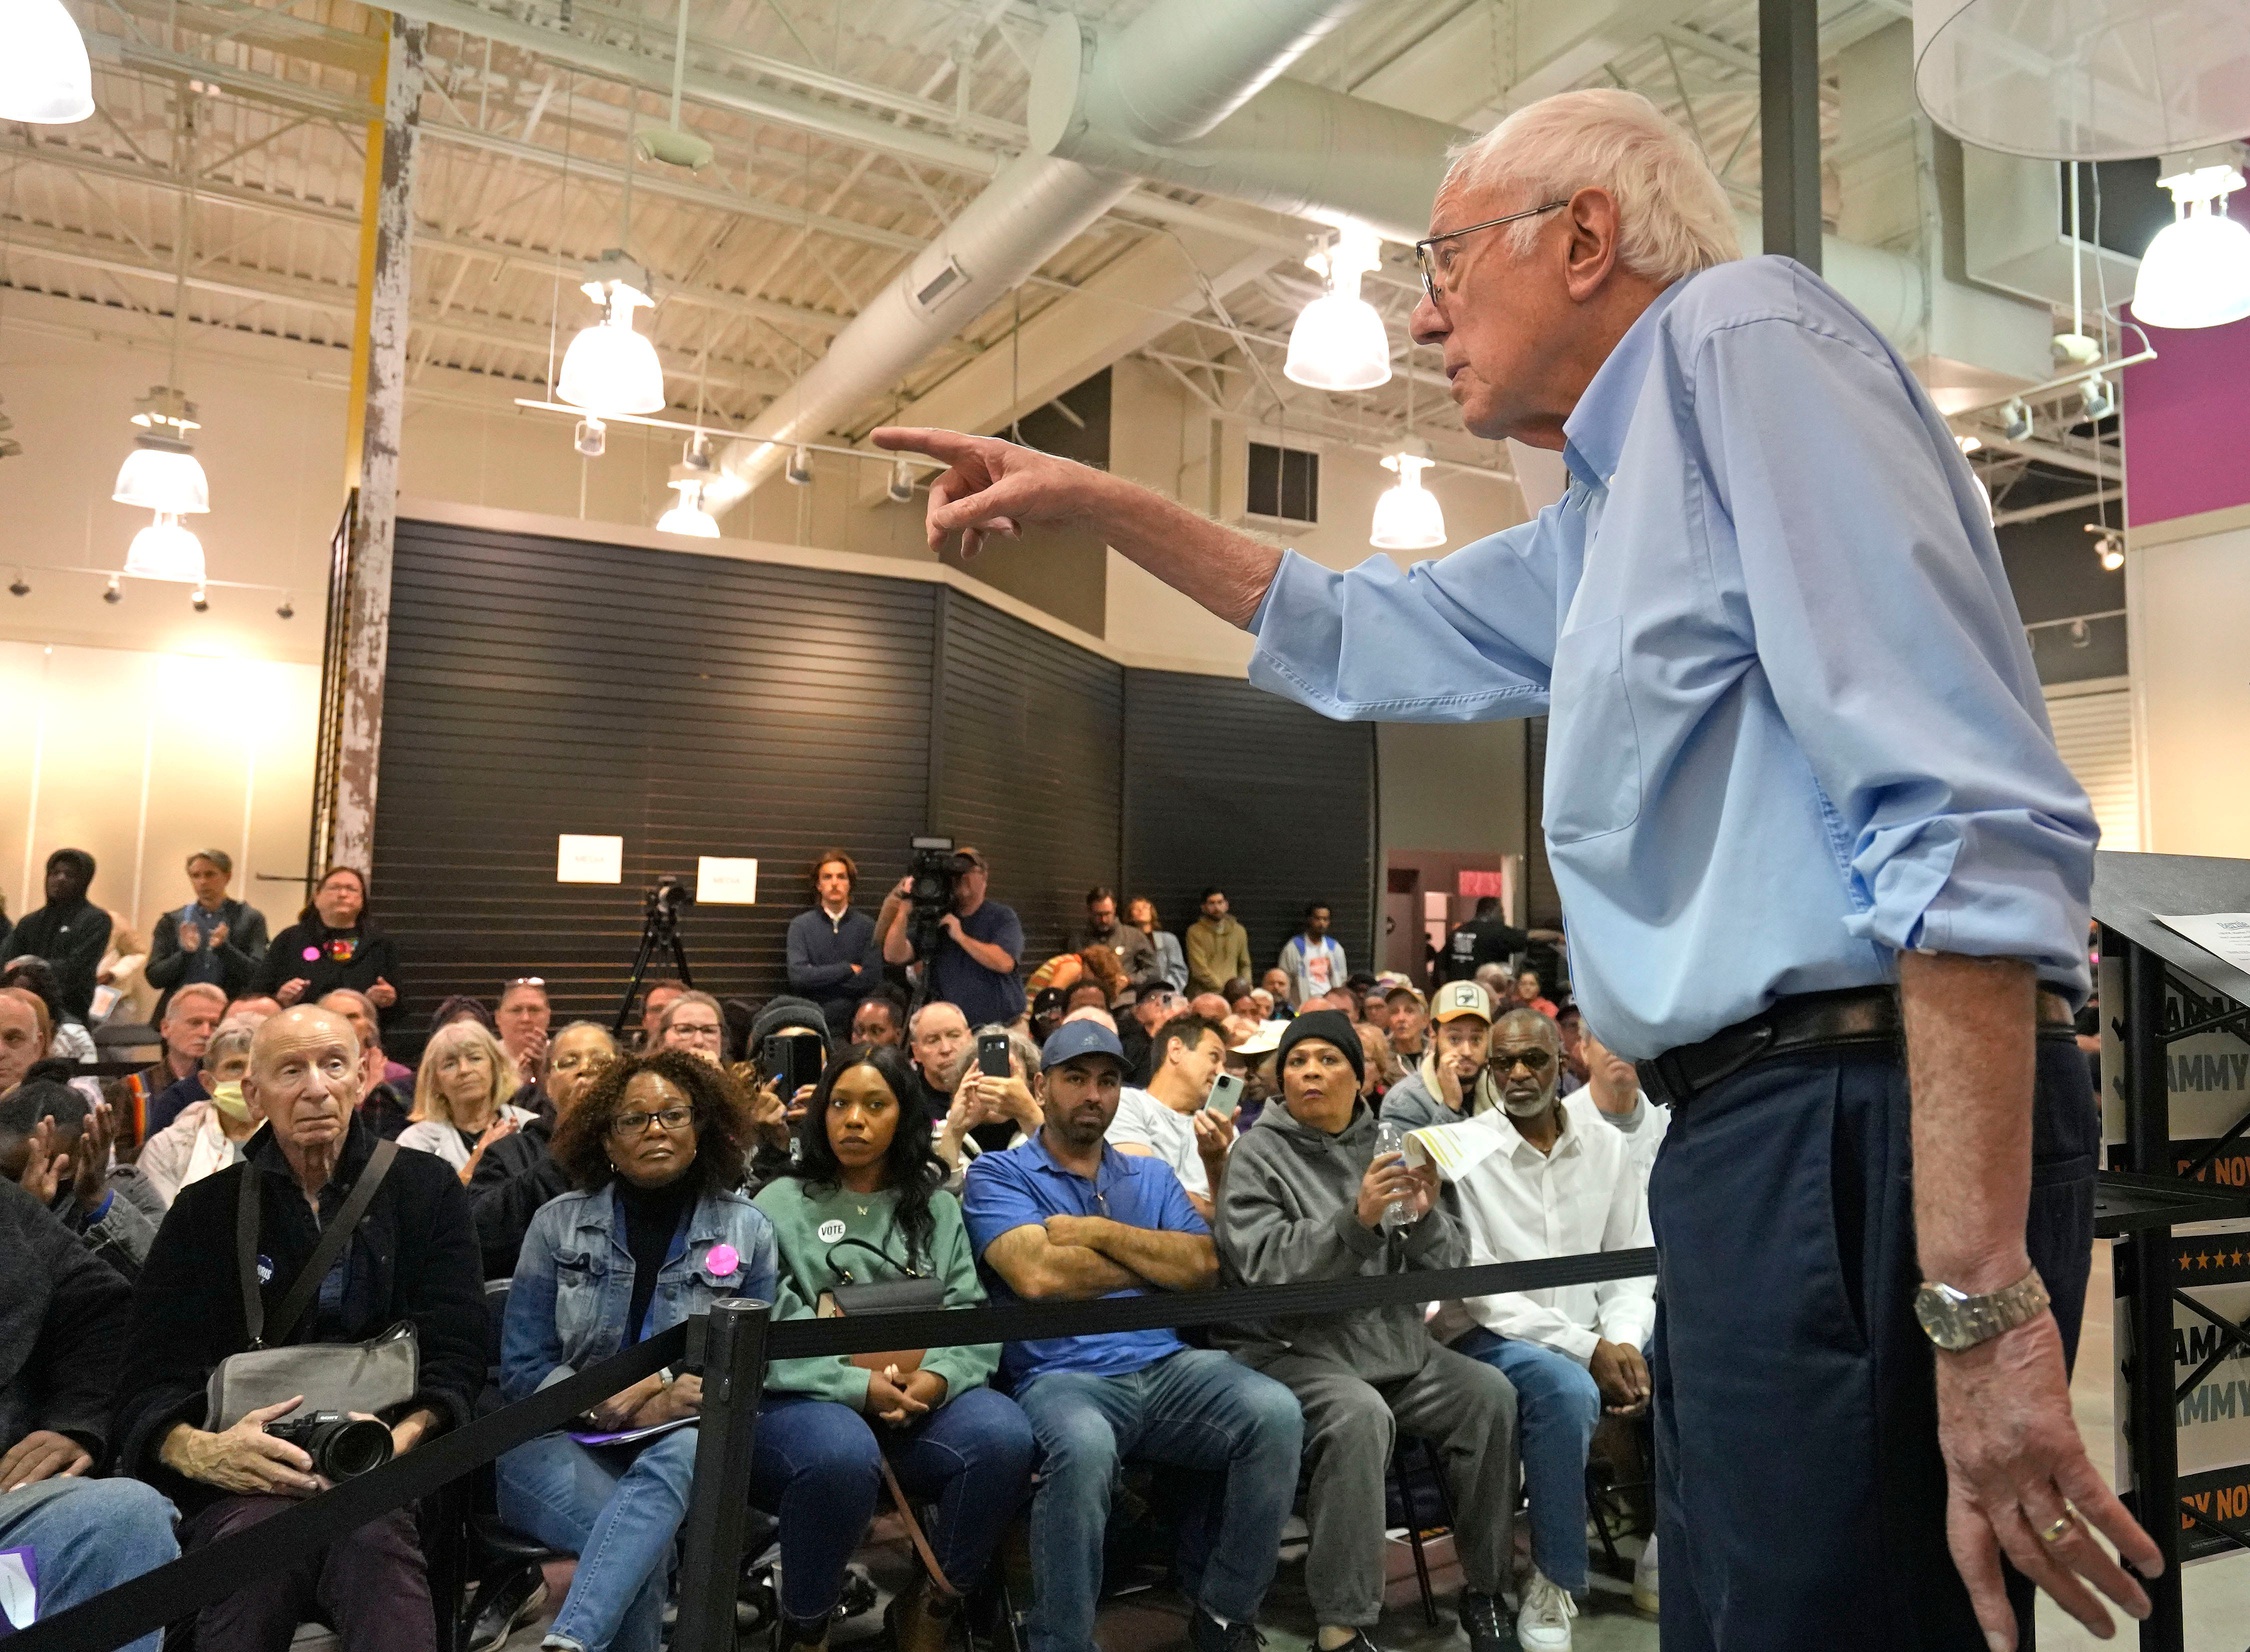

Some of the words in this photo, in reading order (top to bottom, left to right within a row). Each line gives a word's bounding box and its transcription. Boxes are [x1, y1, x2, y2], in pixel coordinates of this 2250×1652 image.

[2167, 1053, 2249, 1092] AMMY
[821, 1225, 843, 1236] VOTE
[2216, 1484, 2250, 1521] NO
